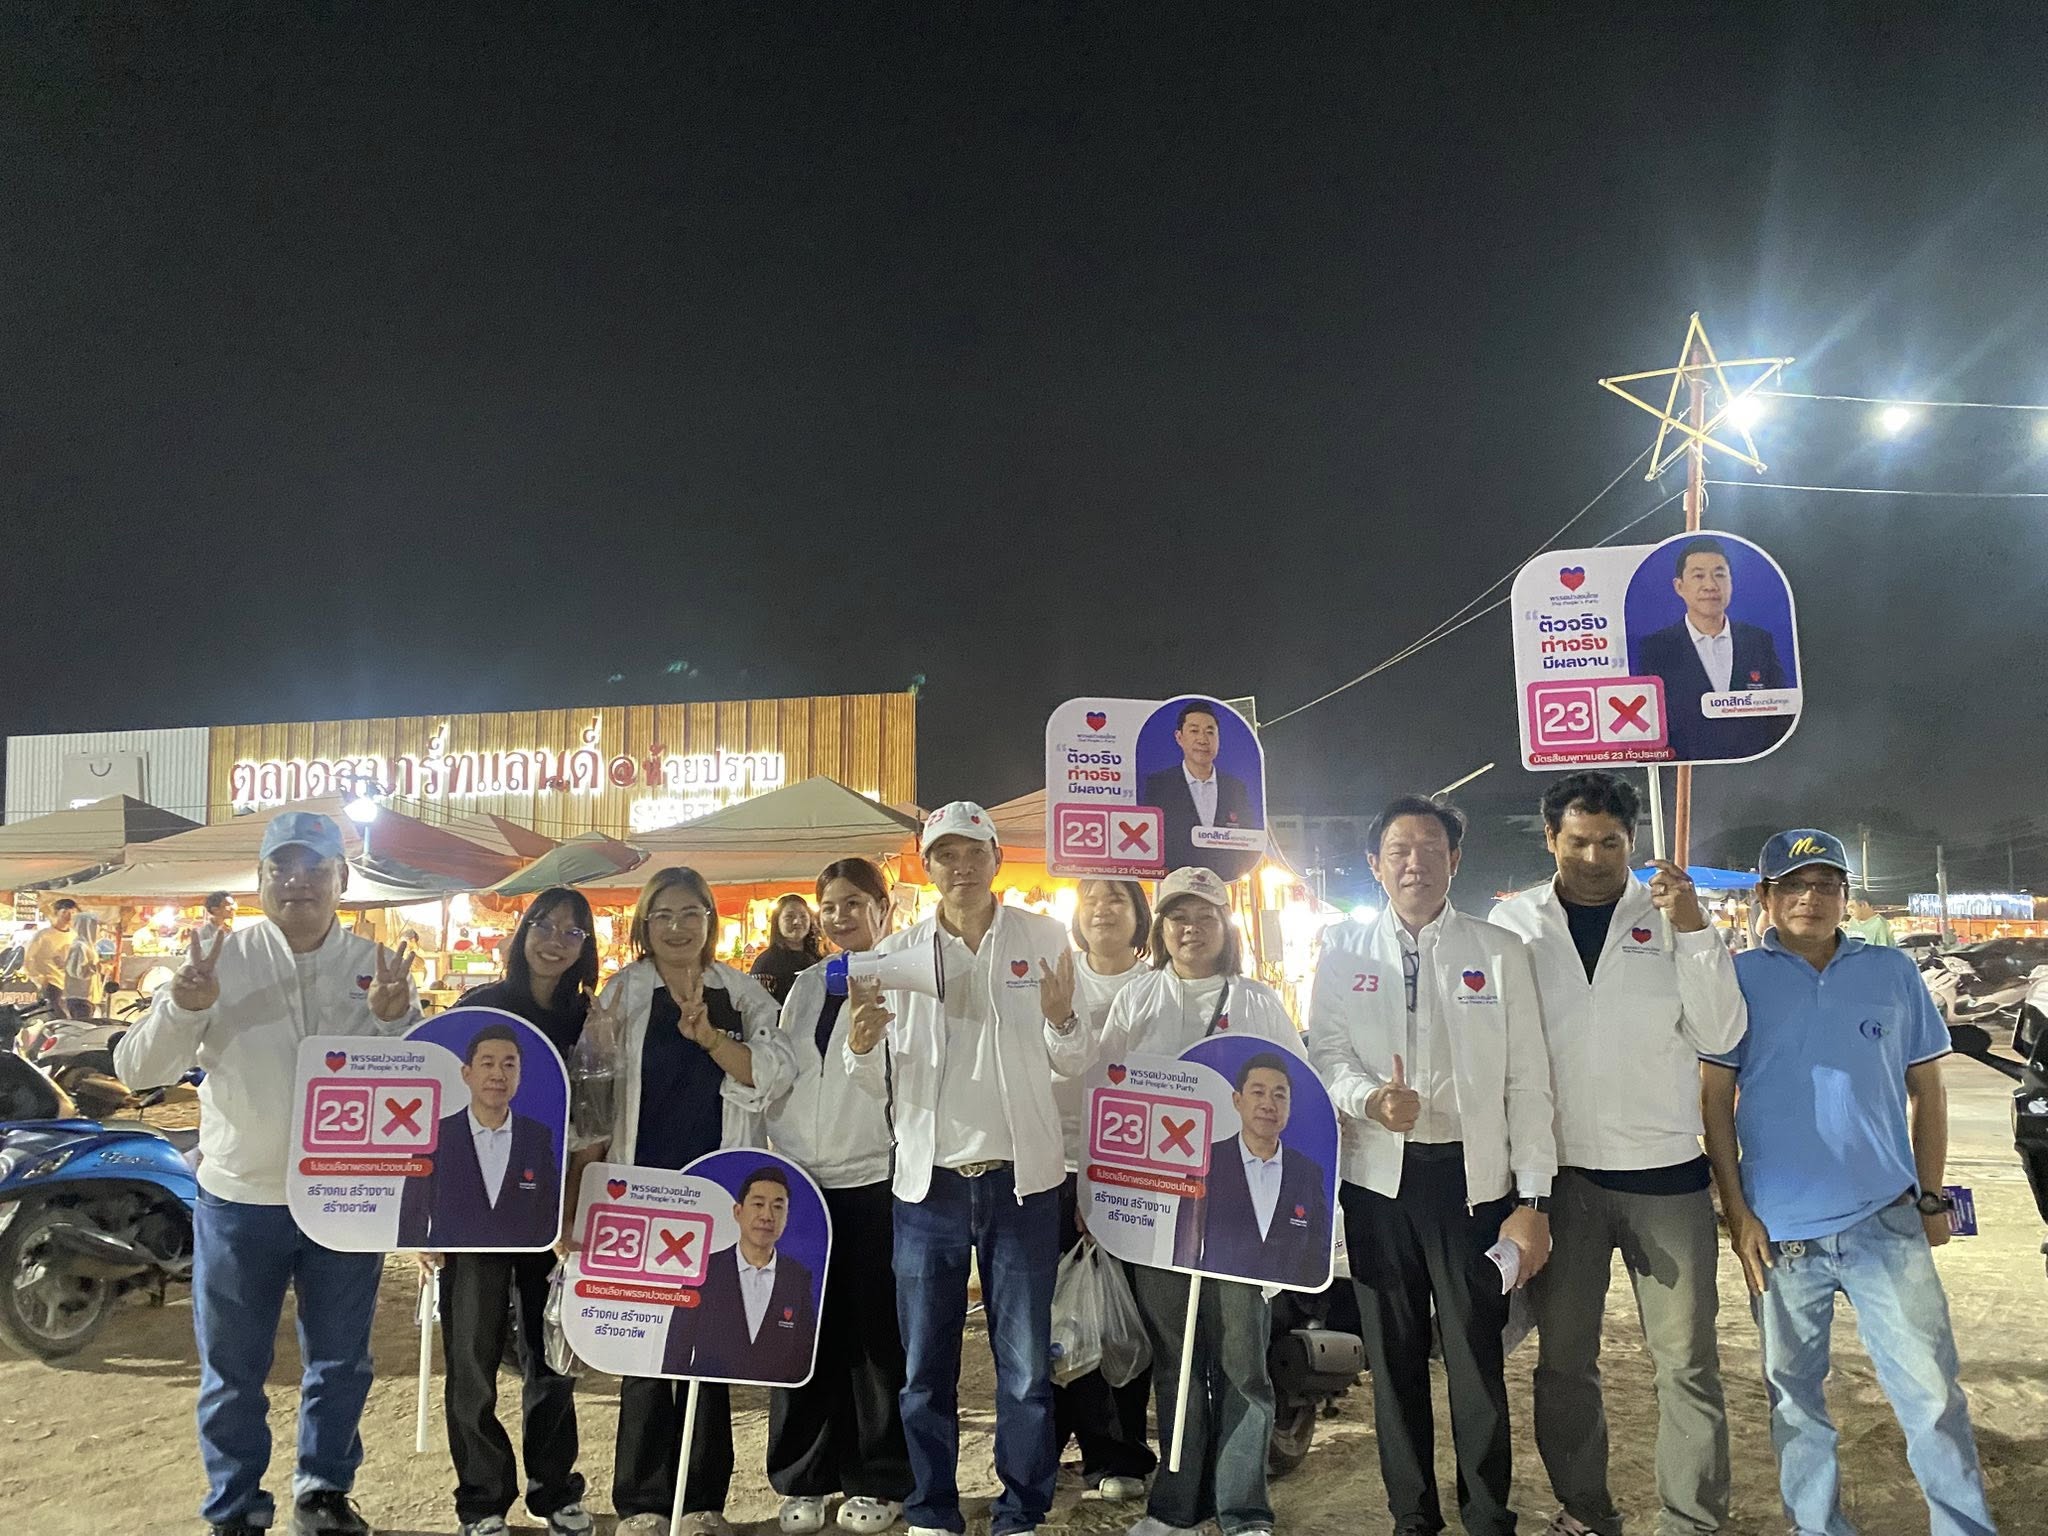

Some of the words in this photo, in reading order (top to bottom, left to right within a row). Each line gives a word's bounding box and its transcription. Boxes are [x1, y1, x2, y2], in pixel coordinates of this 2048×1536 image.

[1542, 634, 1608, 653] ทำจริง
[1543, 702, 1591, 733] 23
[1068, 766, 1121, 782] ทำจริง
[1065, 820, 1104, 848] 23
[1352, 974, 1379, 992] 23
[318, 1100, 365, 1132] 23
[1102, 1112, 1144, 1145] 23
[308, 1184, 348, 1196] สร้างคน
[350, 1184, 395, 1196] สร้างงาน
[323, 1200, 377, 1213] สร้างอาชีพ
[1094, 1191, 1129, 1207] สร้างคน
[1130, 1197, 1171, 1214] สร้างงาน
[1108, 1210, 1155, 1228] สร้างอาชีพ
[596, 1226, 642, 1259] 23
[581, 1306, 619, 1320] สร้างคน
[621, 1310, 664, 1324] สร้างงาน
[594, 1324, 646, 1338] สร้างอาชีพ
